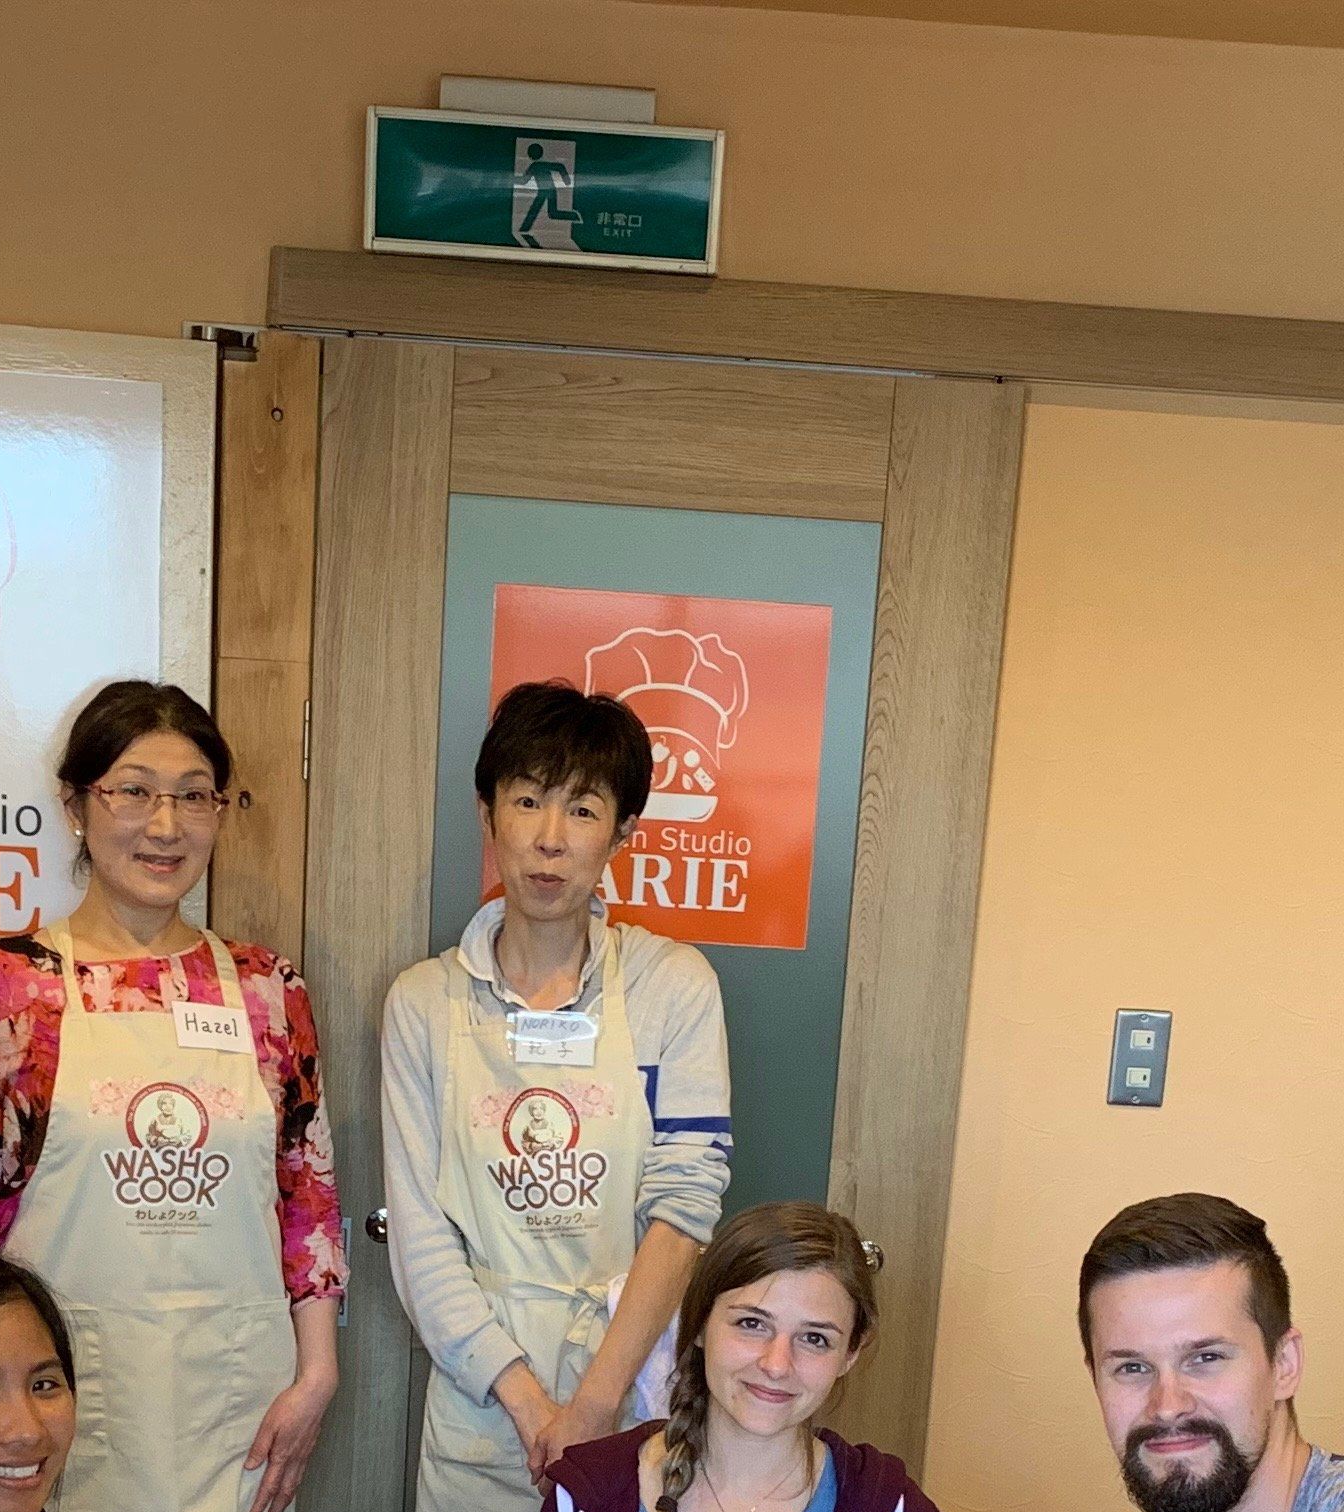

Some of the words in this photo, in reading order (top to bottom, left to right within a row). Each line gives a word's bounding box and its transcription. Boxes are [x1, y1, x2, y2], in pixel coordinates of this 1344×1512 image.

[597, 211, 642, 227] 非常口
[603, 228, 632, 238] EXIT
[659, 826, 752, 856] Studio
[596, 853, 749, 913] ARIE
[184, 1012, 238, 1037] Hazel
[520, 1018, 580, 1035] NORIKO
[104, 1149, 230, 1182] WASHO
[487, 1152, 607, 1189] WASHO
[116, 1176, 221, 1207] COOK
[505, 1179, 599, 1212] COOK
